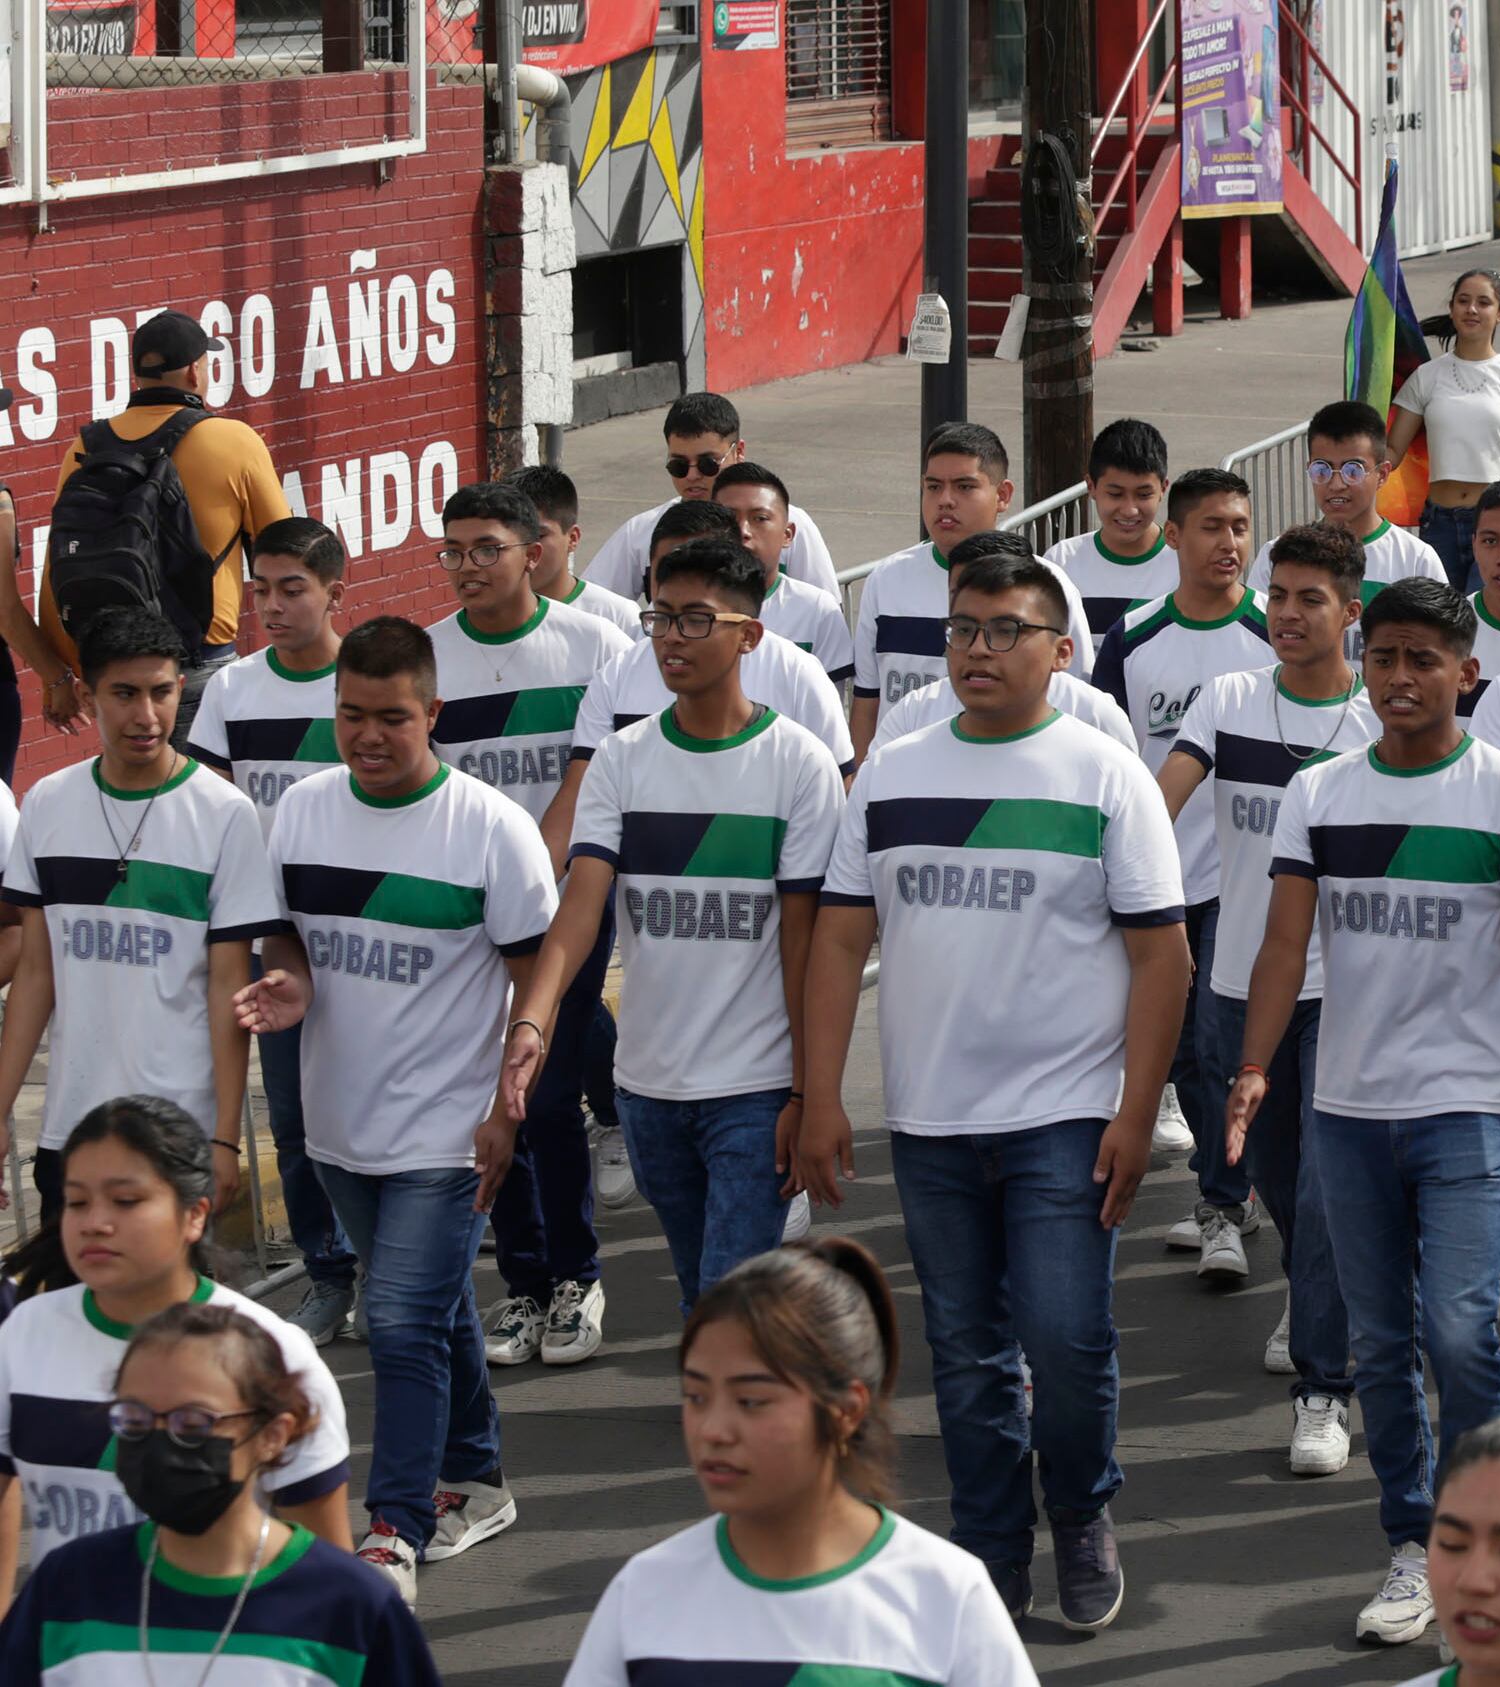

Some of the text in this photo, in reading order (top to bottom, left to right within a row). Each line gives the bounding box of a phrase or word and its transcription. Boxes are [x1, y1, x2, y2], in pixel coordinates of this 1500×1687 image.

[527, 6, 542, 36] DJ
[543, 5, 558, 35] EN
[200, 293, 276, 408] 60
[301, 248, 456, 389] AÑOS
[897, 863, 1037, 912] COBAEP
[1330, 890, 1463, 942] COBAEP
[307, 929, 435, 985] COBAEP
